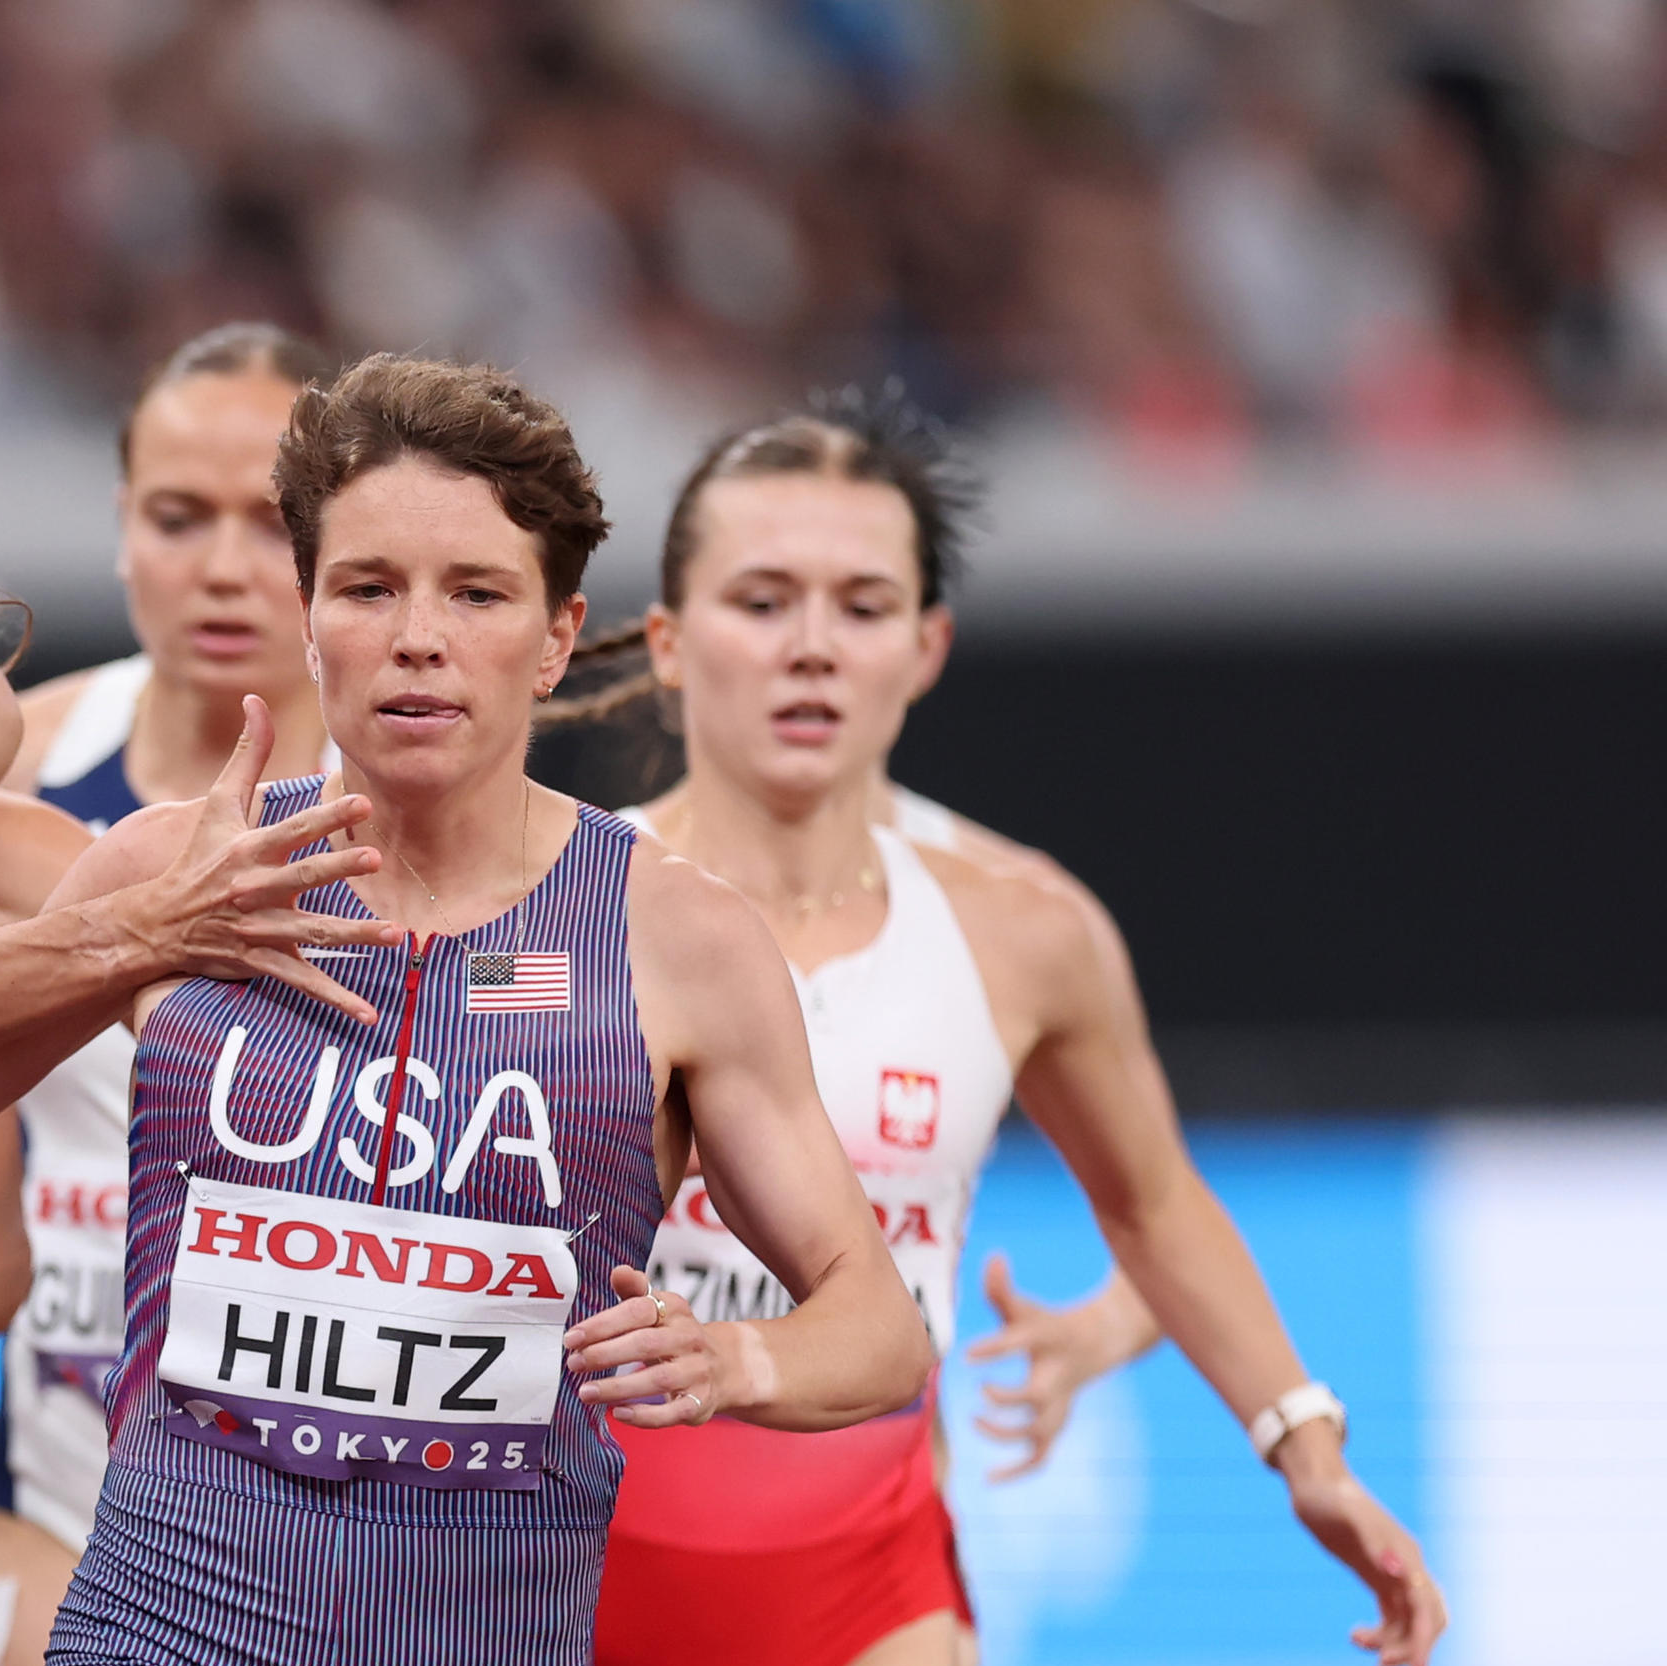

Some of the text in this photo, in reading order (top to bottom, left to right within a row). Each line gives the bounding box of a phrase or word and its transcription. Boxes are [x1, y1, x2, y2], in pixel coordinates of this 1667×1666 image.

[209, 1026, 562, 1209] USA
[187, 1207, 565, 1300] HONDA
[217, 1304, 506, 1412] HILTZ
